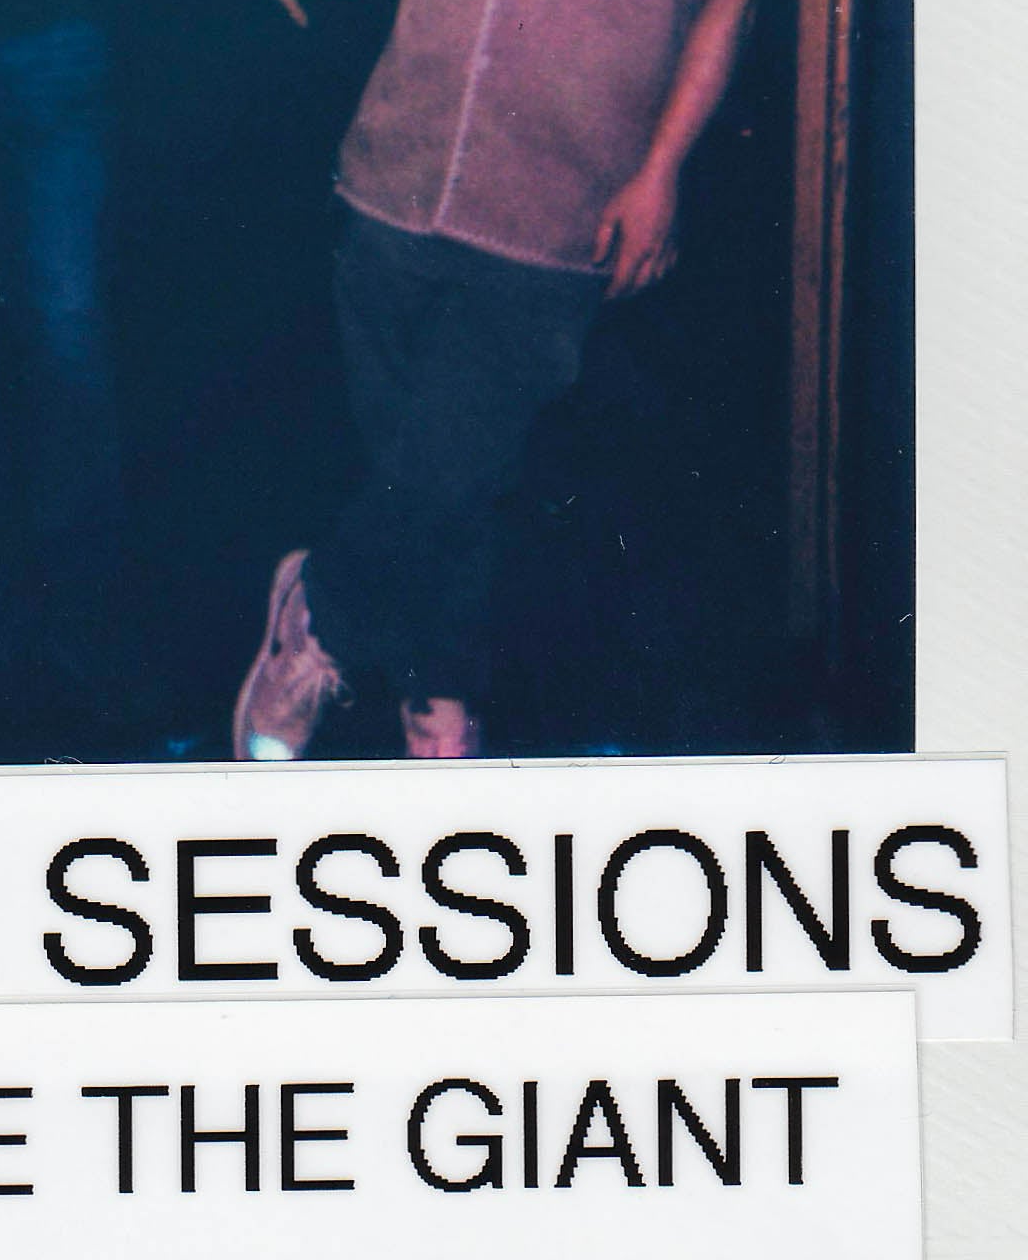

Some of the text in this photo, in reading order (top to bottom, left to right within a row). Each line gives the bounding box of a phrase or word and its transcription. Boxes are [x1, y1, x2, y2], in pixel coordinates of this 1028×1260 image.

[44, 825, 982, 986] SESSIONS
[81, 1083, 356, 1193] THE
[408, 1077, 839, 1192] GIANT
